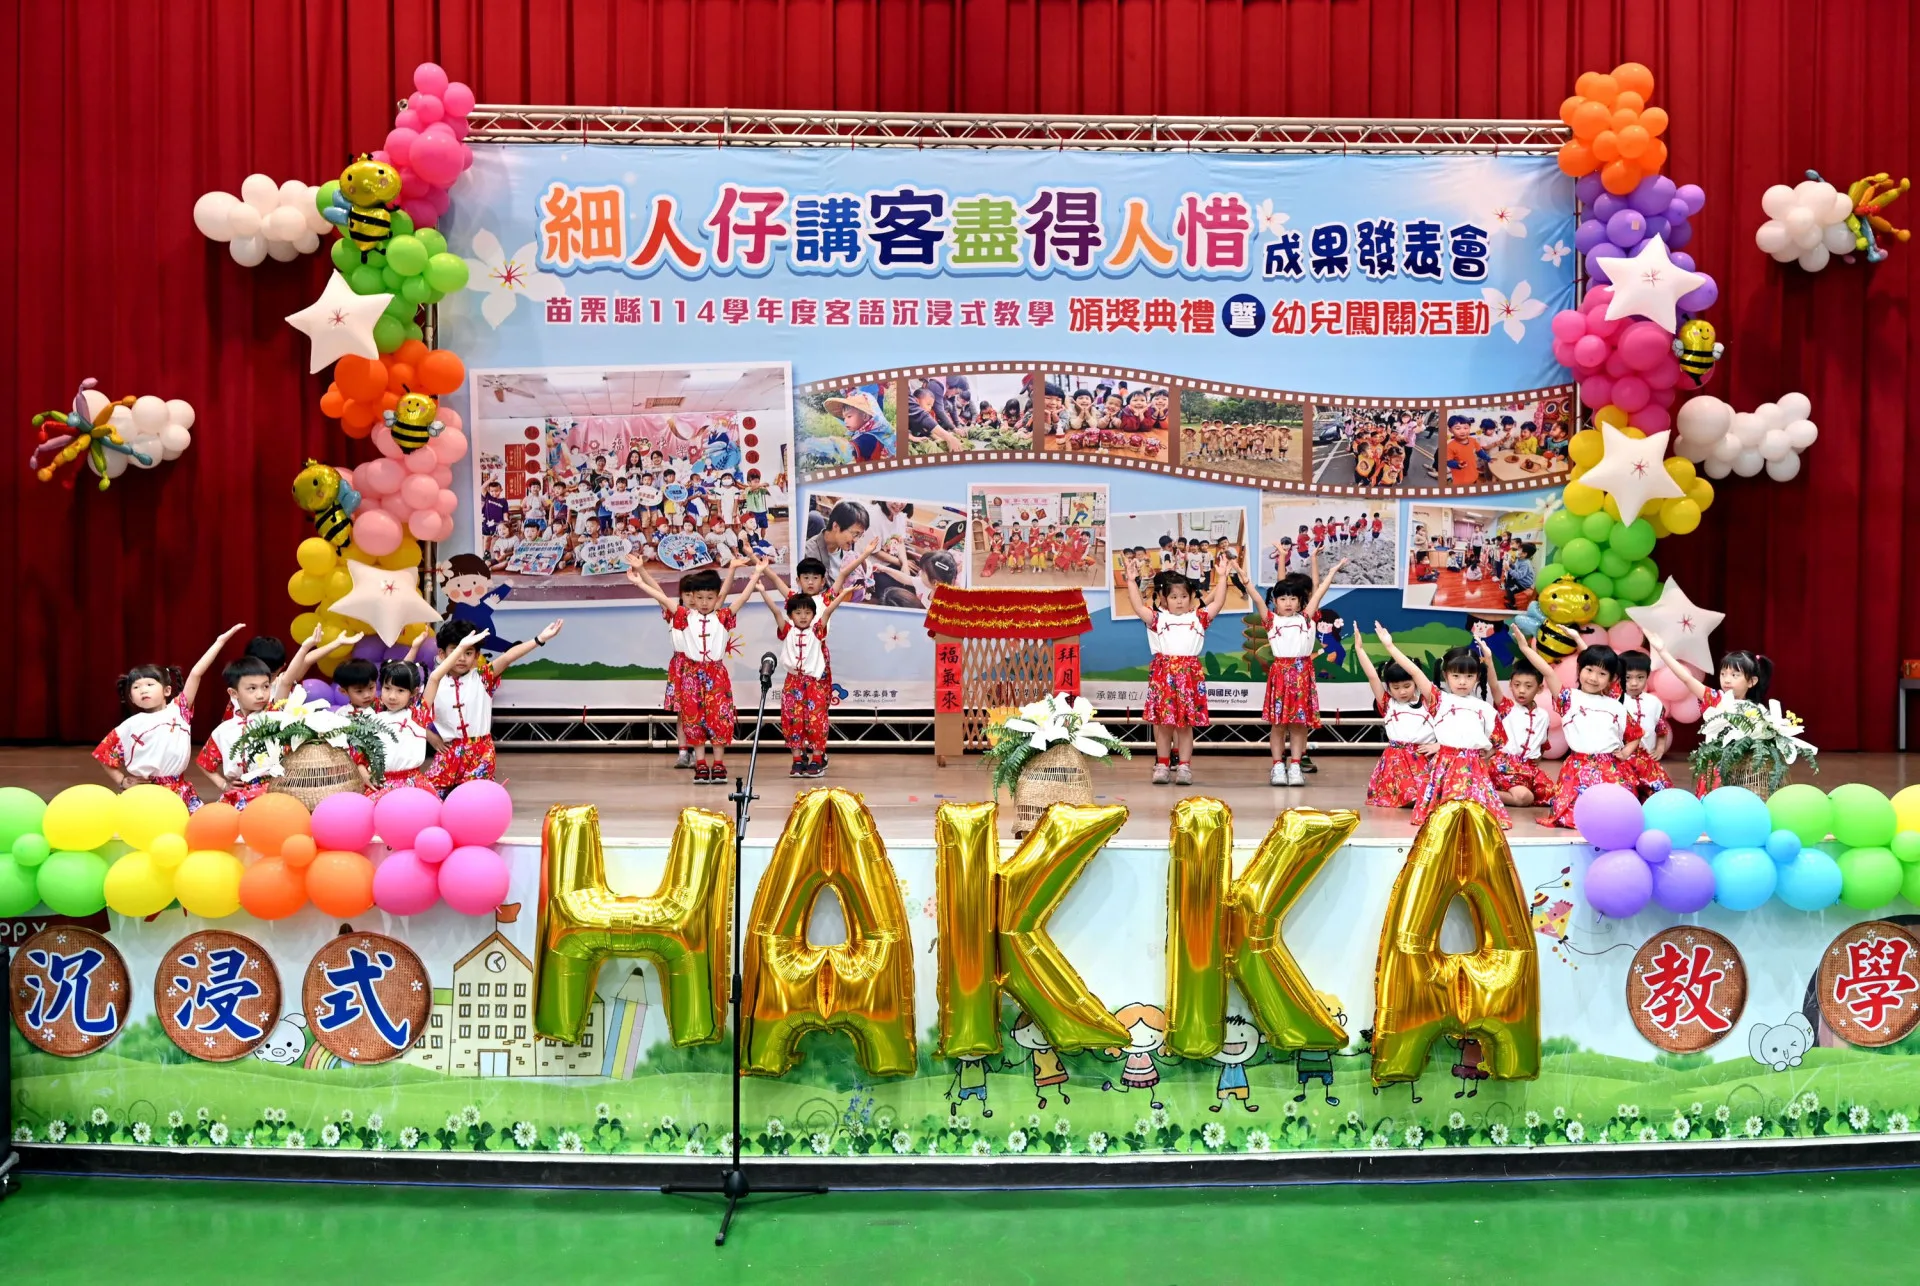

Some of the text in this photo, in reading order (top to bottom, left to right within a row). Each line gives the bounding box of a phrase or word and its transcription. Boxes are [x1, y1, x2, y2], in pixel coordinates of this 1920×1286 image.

[544, 186, 1489, 278] 細人仔講客盡得人惜 成果發表會
[546, 297, 1055, 327] 苗栗縣114學年度客語沉浸式教學
[1227, 301, 1260, 330] 暨
[1271, 299, 1491, 336] 幼兒闖關活動
[852, 689, 898, 698] 客家委員會
[938, 646, 961, 709] 福氣來
[534, 786, 1541, 1086] HAKKA
